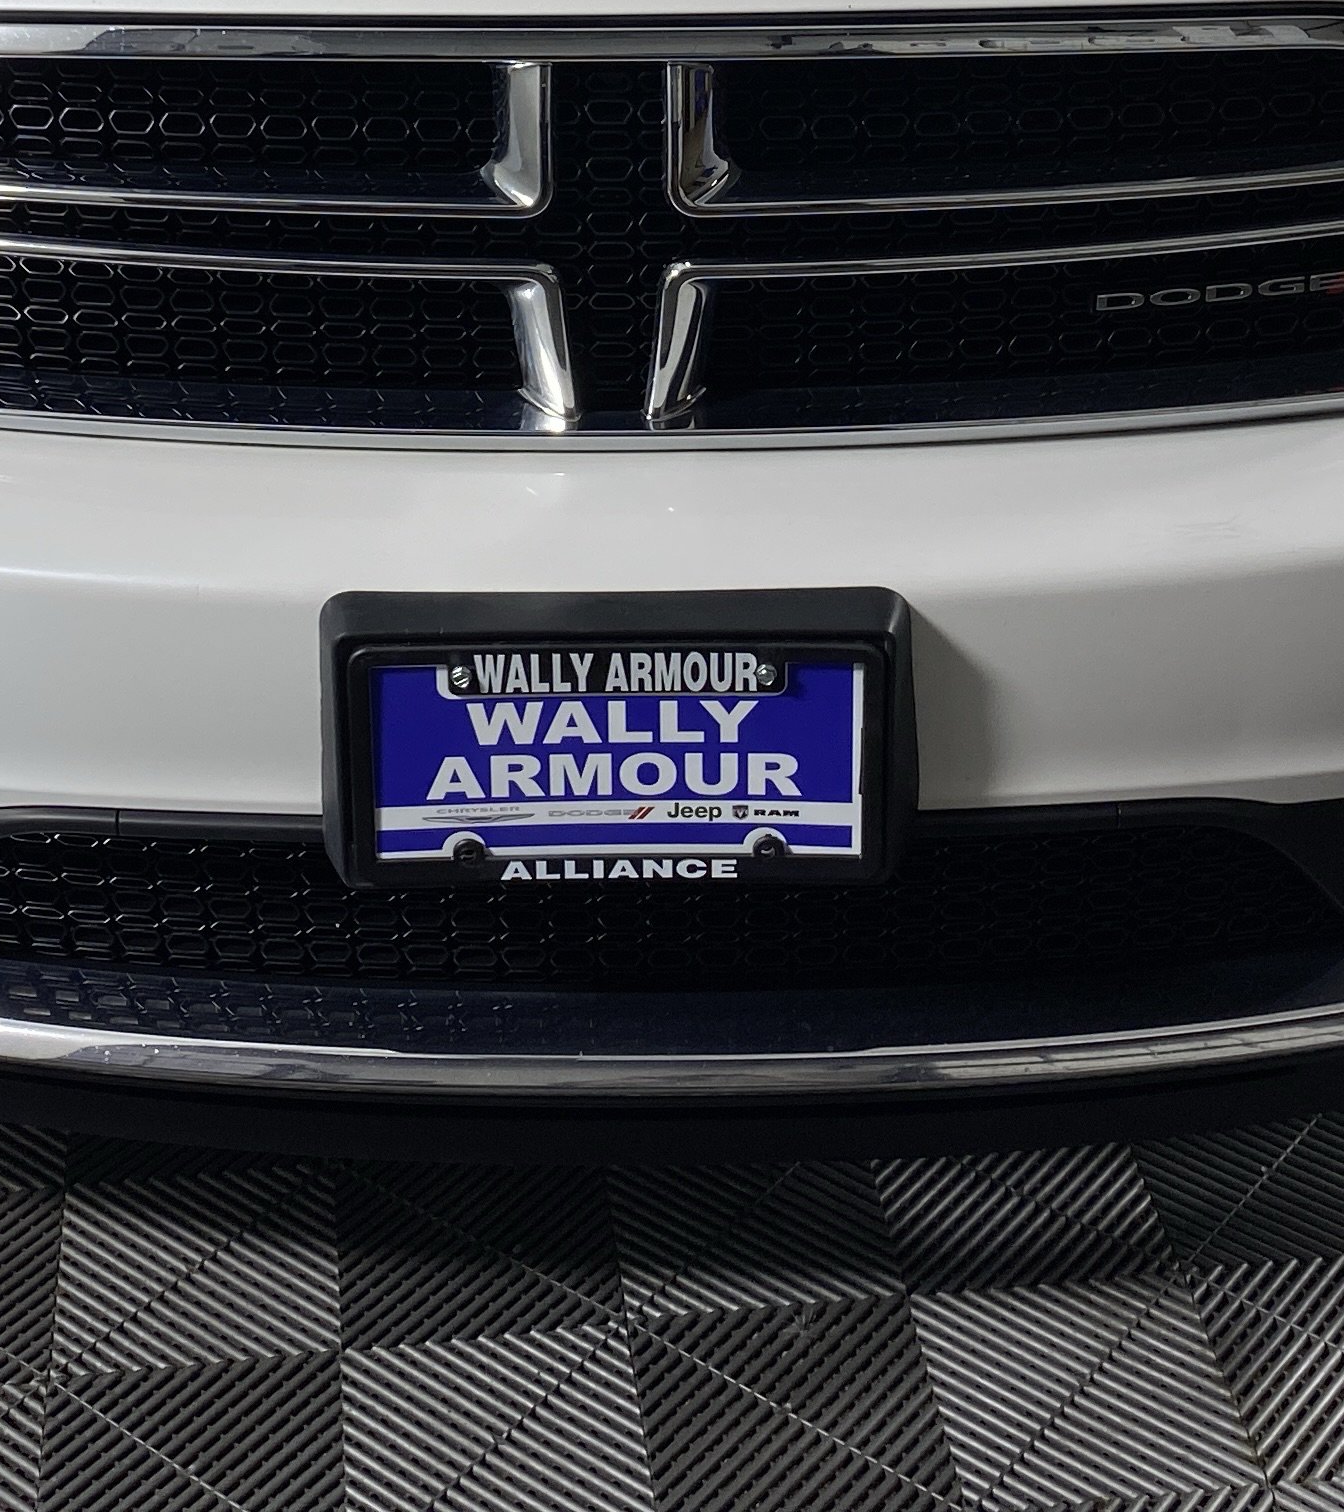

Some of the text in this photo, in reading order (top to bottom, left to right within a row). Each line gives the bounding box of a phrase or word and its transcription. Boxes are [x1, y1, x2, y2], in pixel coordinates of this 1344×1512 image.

[474, 652, 758, 694] WALLY ARMOUR
[467, 700, 759, 746] WALLY
[426, 752, 803, 801] ARMOUR
[436, 806, 521, 814] CHRYSLER
[667, 802, 722, 821] Jeep
[753, 809, 800, 817] RAM
[501, 859, 738, 881] ALLIANCE
